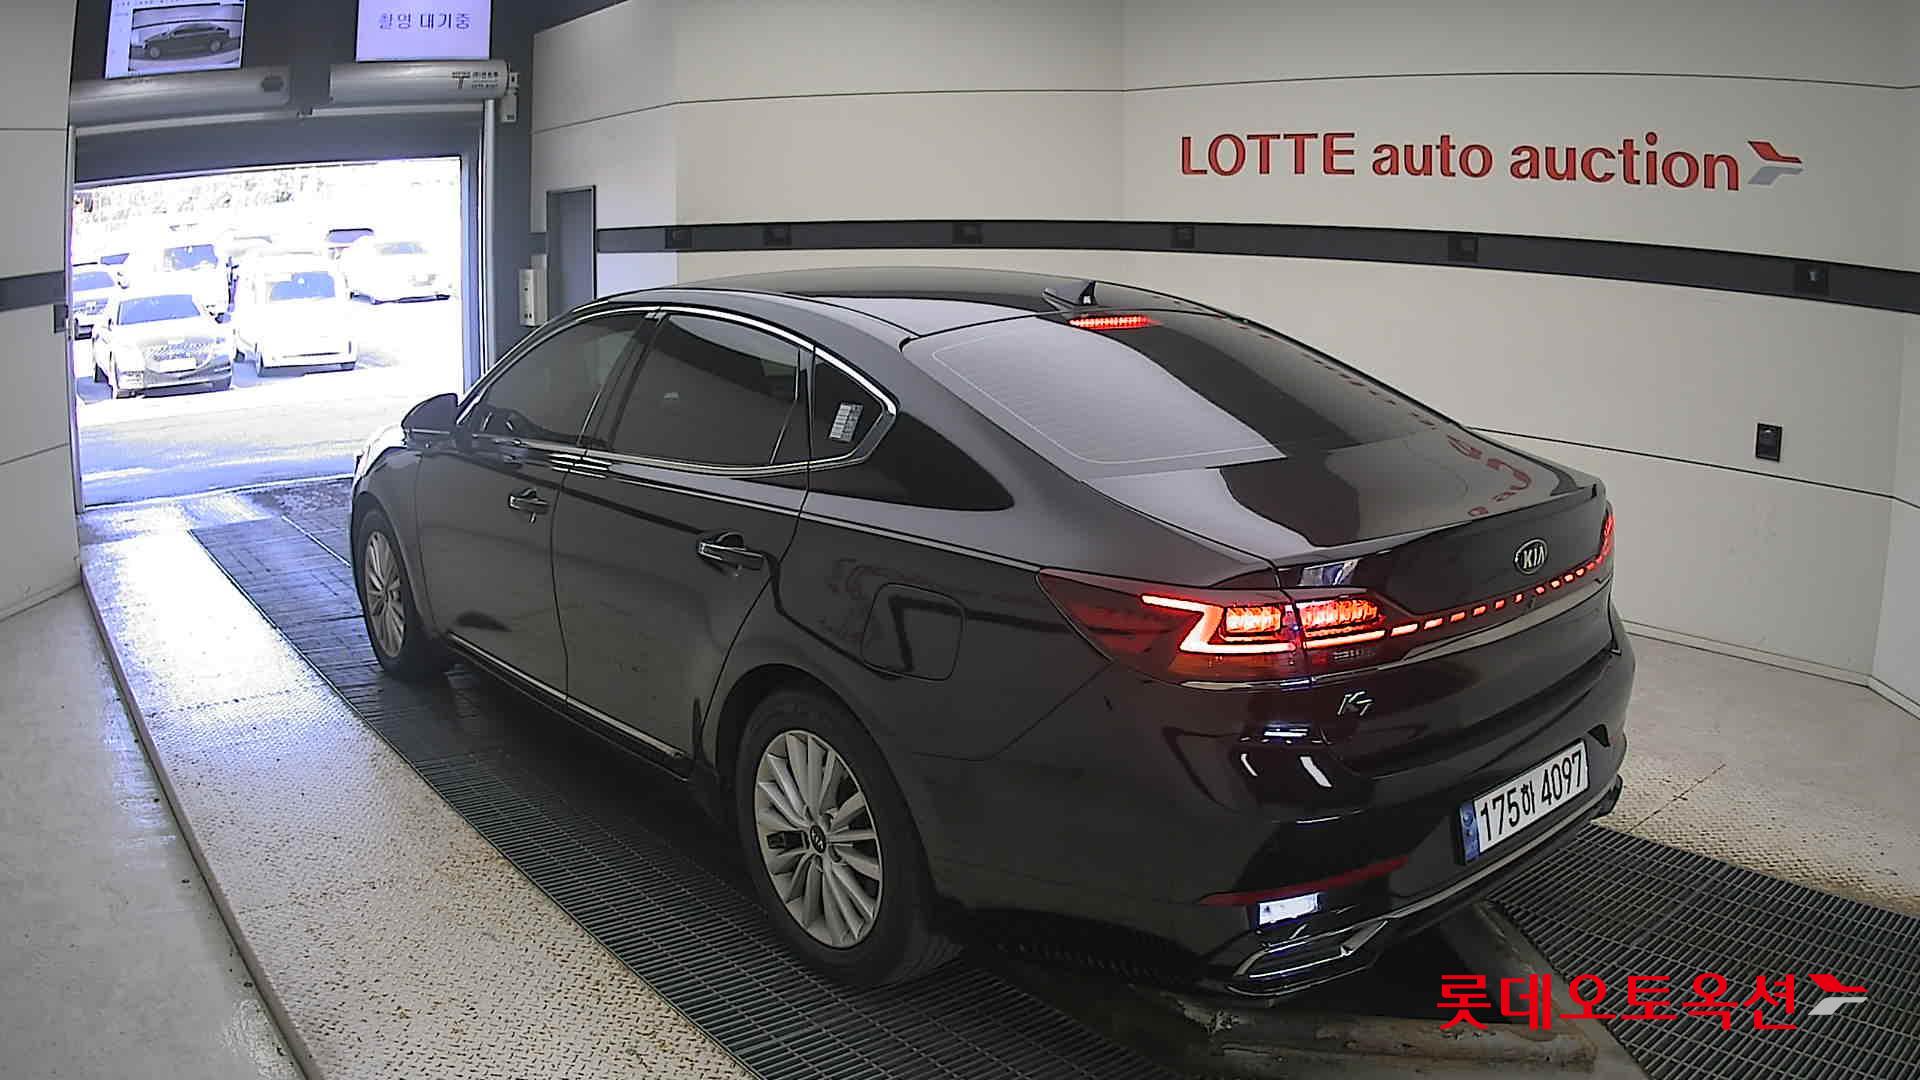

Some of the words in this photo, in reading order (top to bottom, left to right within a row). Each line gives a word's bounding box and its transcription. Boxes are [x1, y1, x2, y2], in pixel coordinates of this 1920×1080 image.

[419, 12, 471, 31] 대기중
[1180, 132, 1356, 176] LOTTE
[1372, 134, 1494, 178] auto
[1509, 131, 1740, 192] auction
[1479, 779, 1537, 843] 175하
[1541, 749, 1583, 807] 4097
